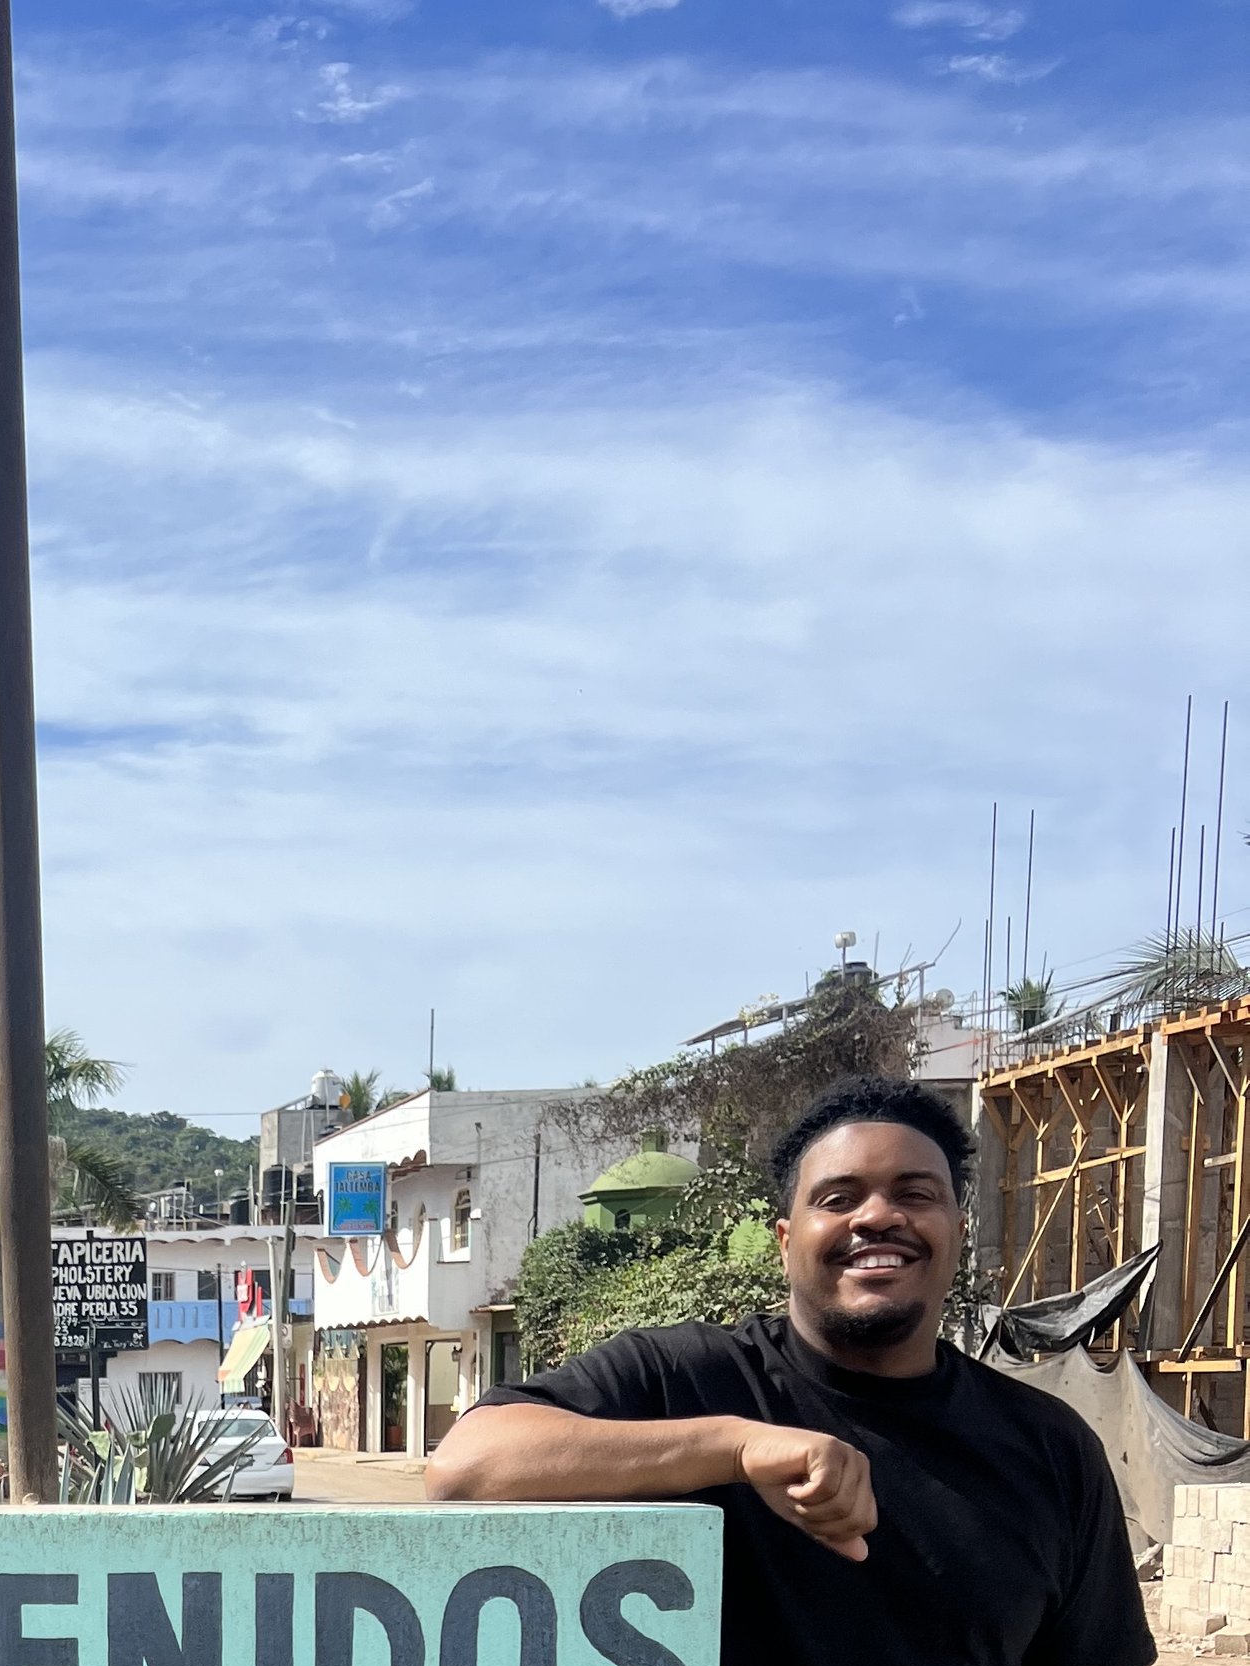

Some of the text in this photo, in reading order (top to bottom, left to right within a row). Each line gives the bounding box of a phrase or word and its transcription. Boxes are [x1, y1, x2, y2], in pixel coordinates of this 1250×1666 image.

[346, 1170, 372, 1181] CASA
[52, 1265, 133, 1284] PHOLSTERY
[86, 1283, 147, 1300] UBICACION
[81, 1301, 118, 1316] PERLA
[120, 1301, 138, 1316] 35
